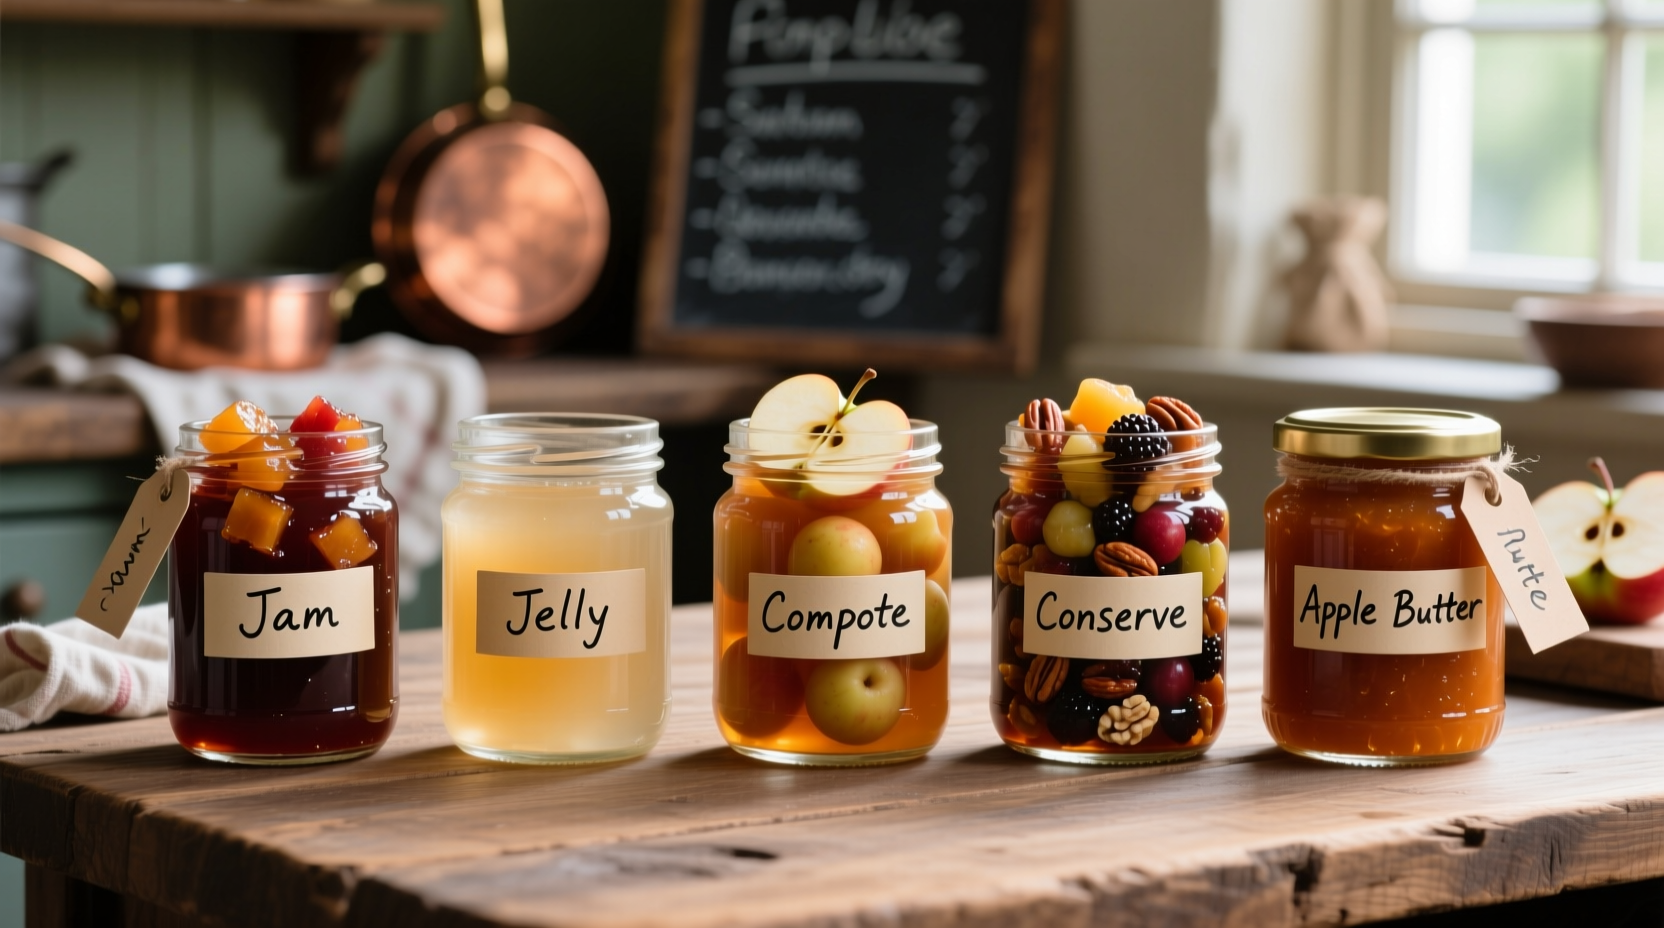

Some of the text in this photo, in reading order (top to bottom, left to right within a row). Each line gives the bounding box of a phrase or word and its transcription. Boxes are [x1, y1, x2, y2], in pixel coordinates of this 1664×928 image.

[238, 586, 340, 639] Jam
[505, 586, 610, 649] Jelly
[760, 590, 911, 650] Compote
[1035, 589, 1188, 634] Conserve
[1299, 582, 1484, 640] Apple Butter
